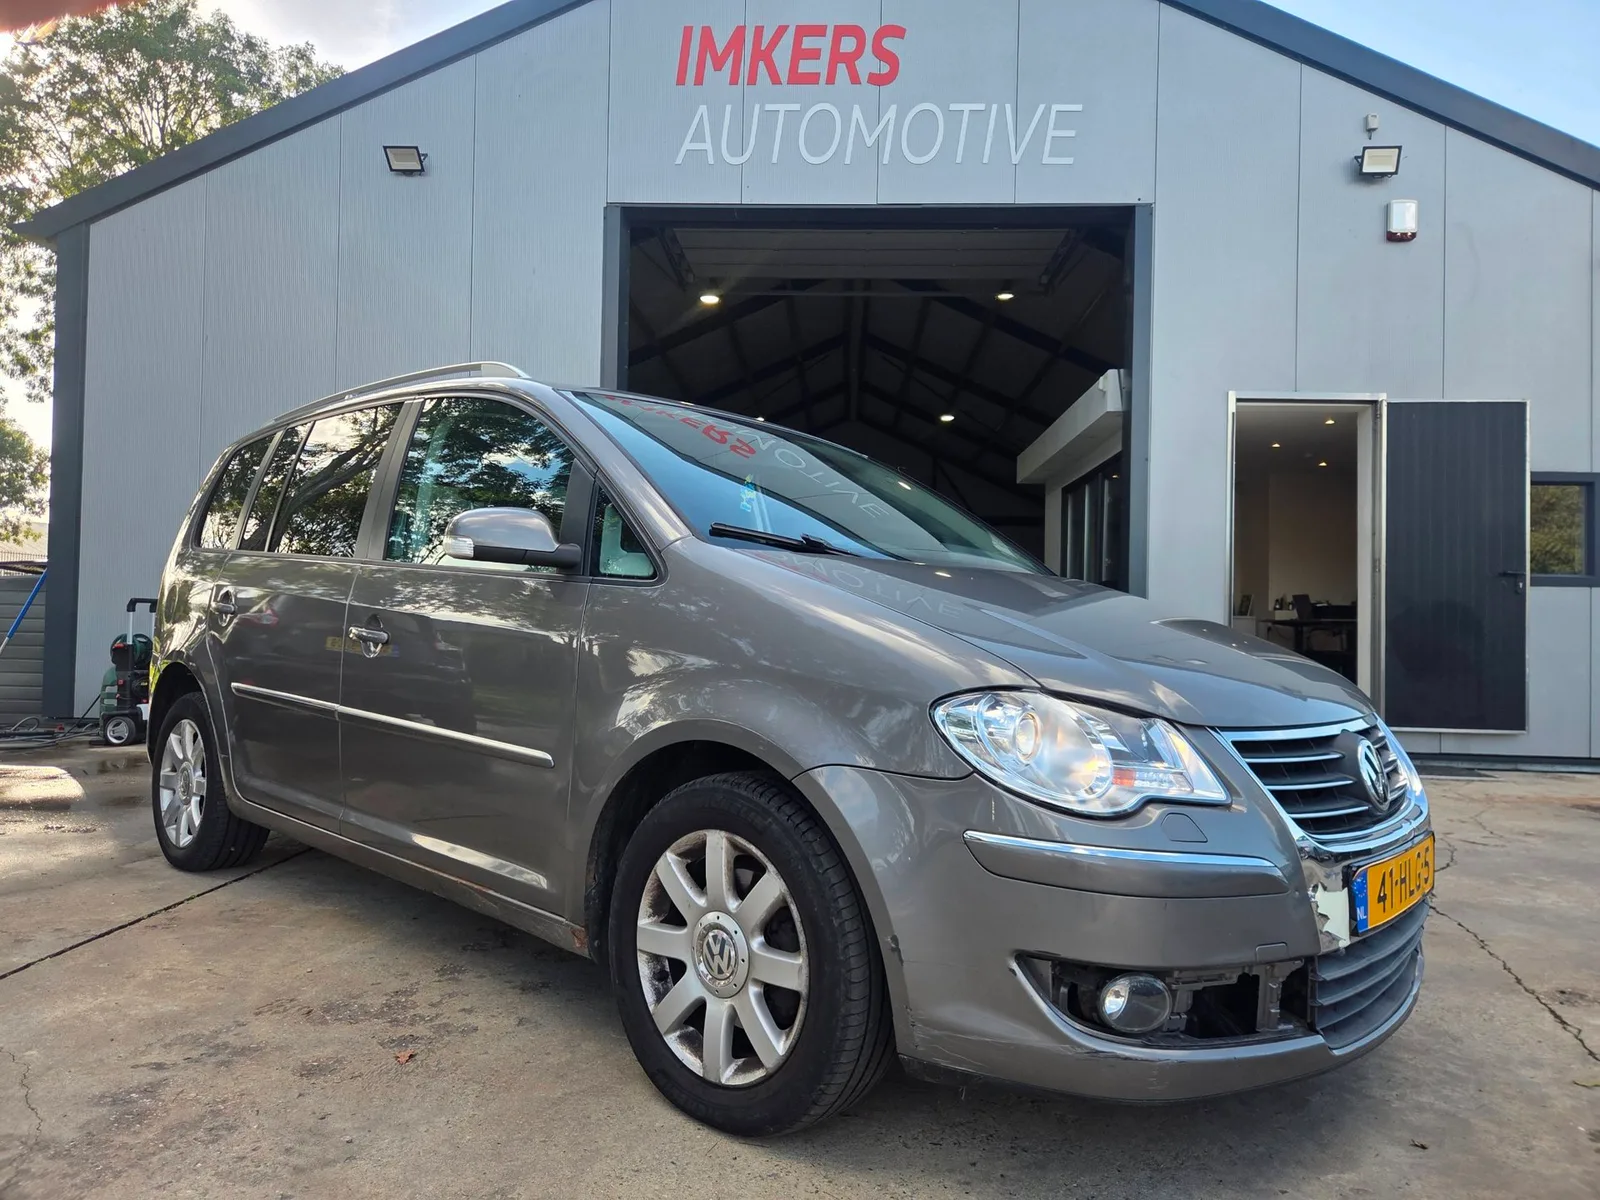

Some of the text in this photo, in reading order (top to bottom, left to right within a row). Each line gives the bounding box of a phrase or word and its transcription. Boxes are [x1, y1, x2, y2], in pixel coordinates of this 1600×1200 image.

[675, 24, 907, 87] IMKERS
[674, 102, 1083, 166] AUTOMOTIVE
[1356, 906, 1367, 921] NL
